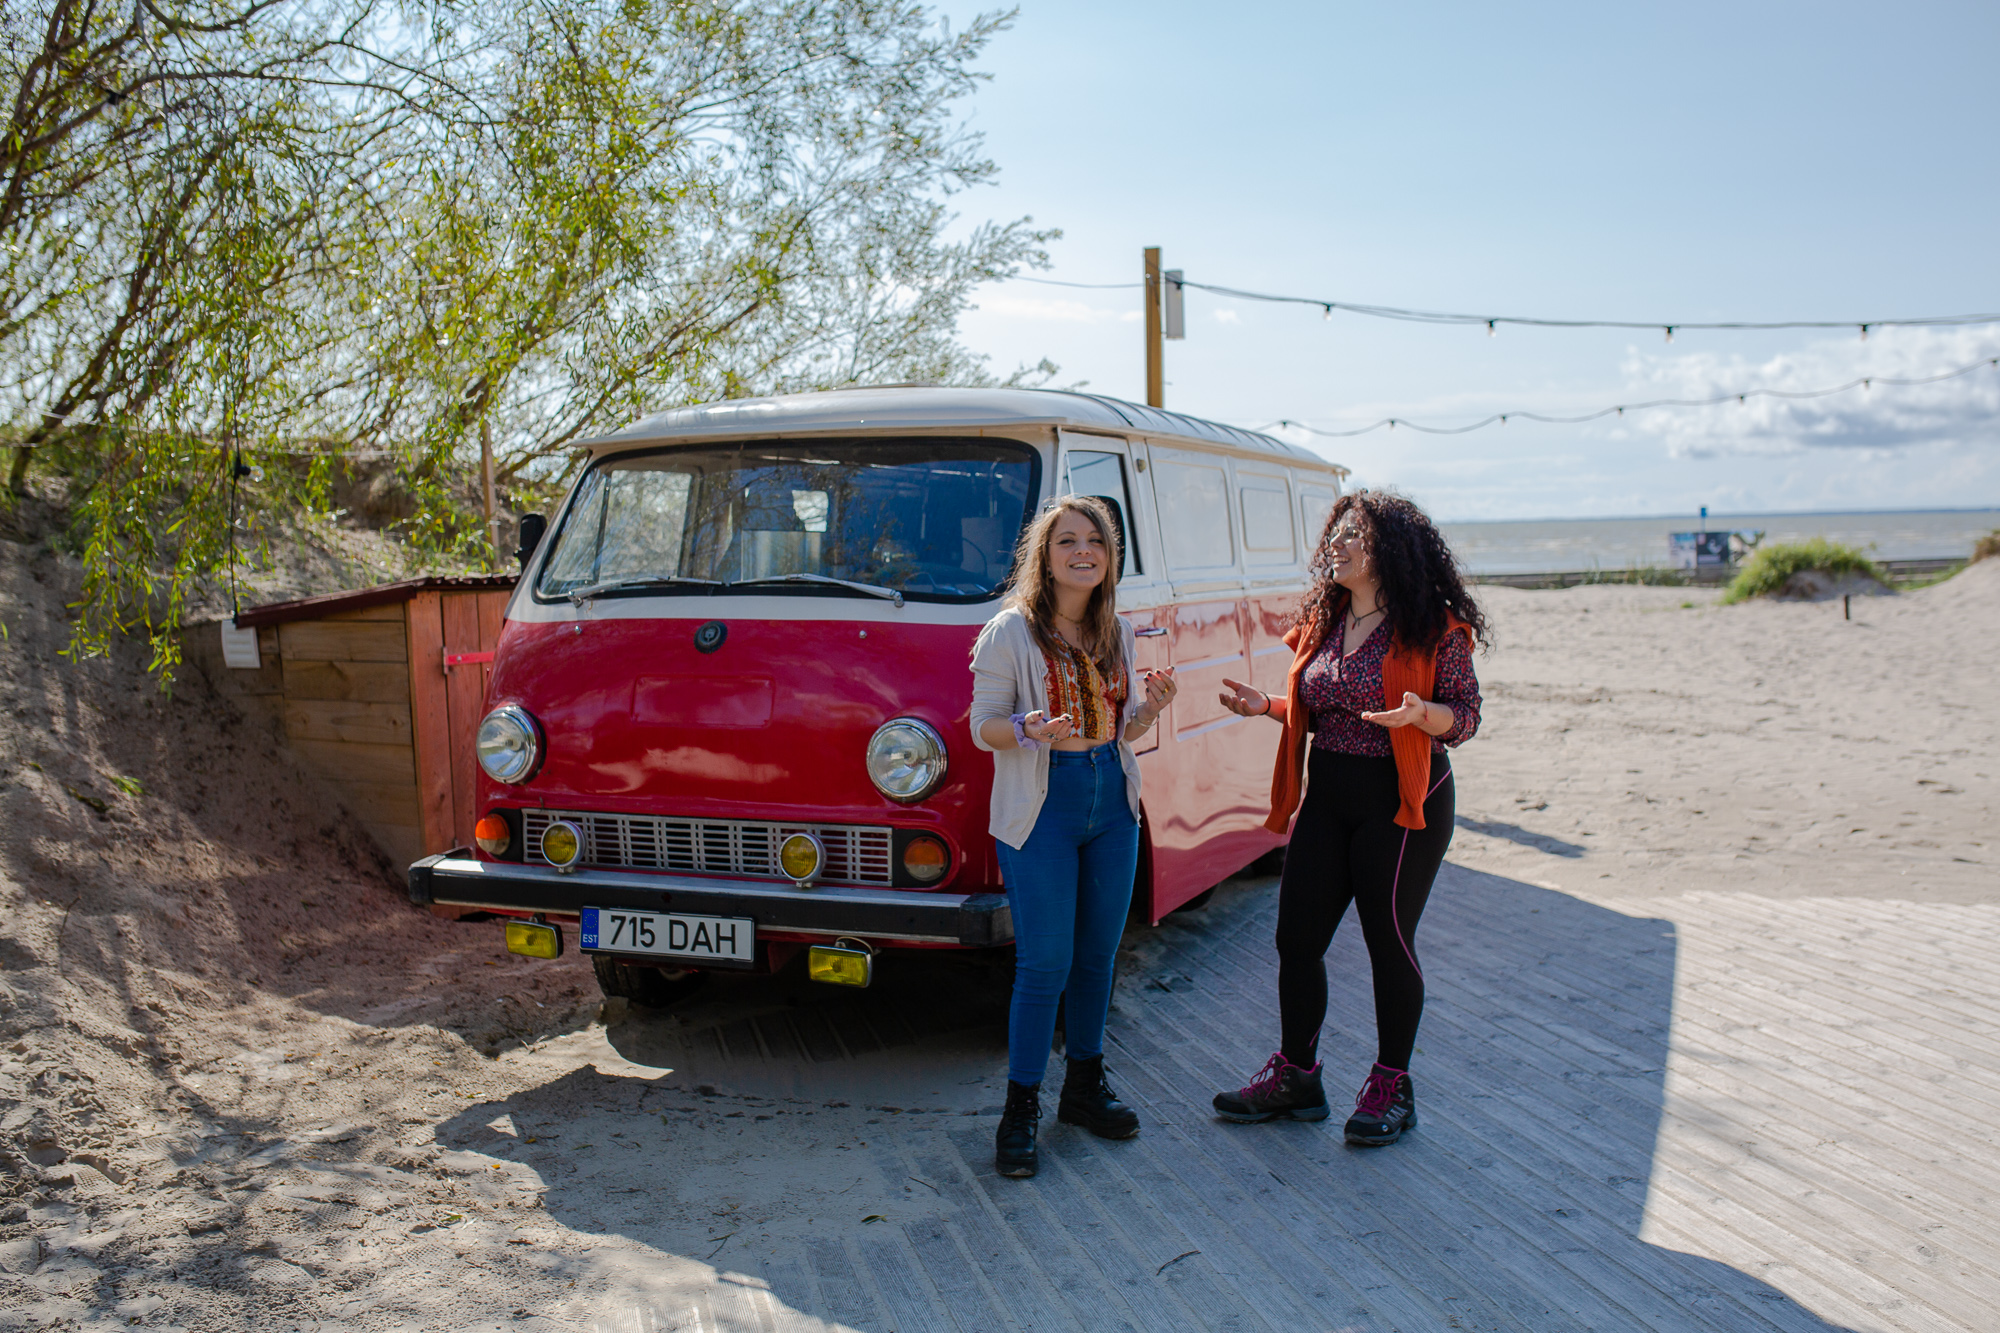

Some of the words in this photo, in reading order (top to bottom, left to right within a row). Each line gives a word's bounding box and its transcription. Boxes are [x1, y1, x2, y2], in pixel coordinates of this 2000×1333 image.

[583, 934, 598, 944] EST
[610, 915, 655, 948] 715
[669, 919, 736, 955] DAH
